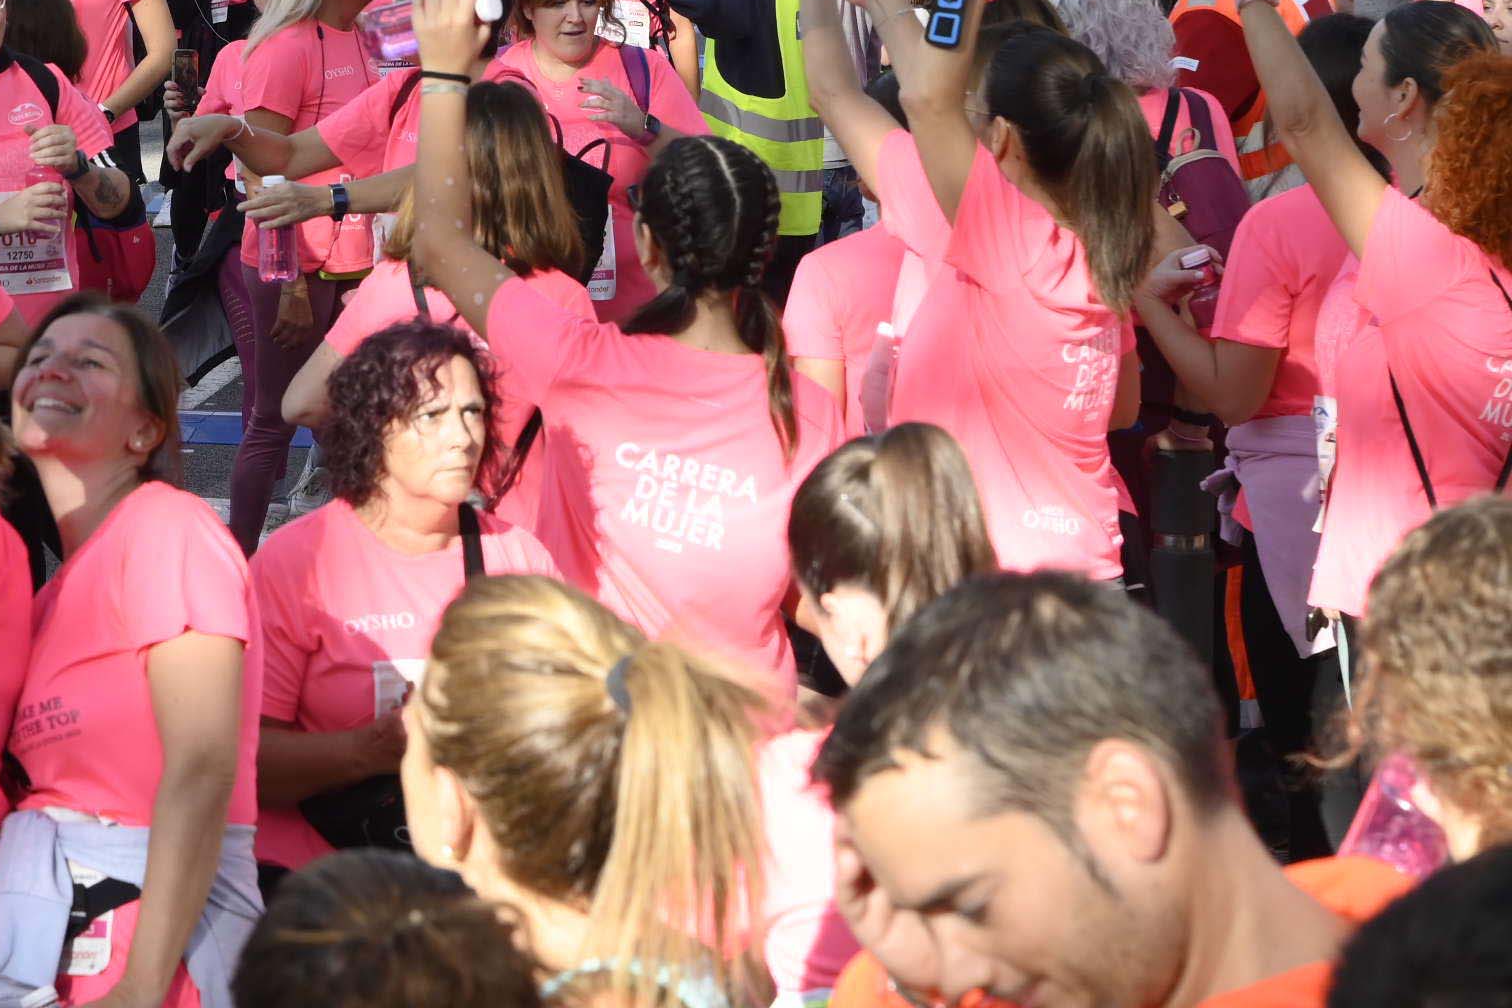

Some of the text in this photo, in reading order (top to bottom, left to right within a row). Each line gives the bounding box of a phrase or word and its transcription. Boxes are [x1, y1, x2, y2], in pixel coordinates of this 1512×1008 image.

[7, 250, 34, 261] 12750
[615, 441, 758, 505] CARRERA
[635, 474, 724, 519] DE LA
[621, 498, 726, 552] MUJER
[343, 611, 414, 636] OYSHO
[40, 696, 63, 712] ME
[48, 709, 81, 730] TOP
